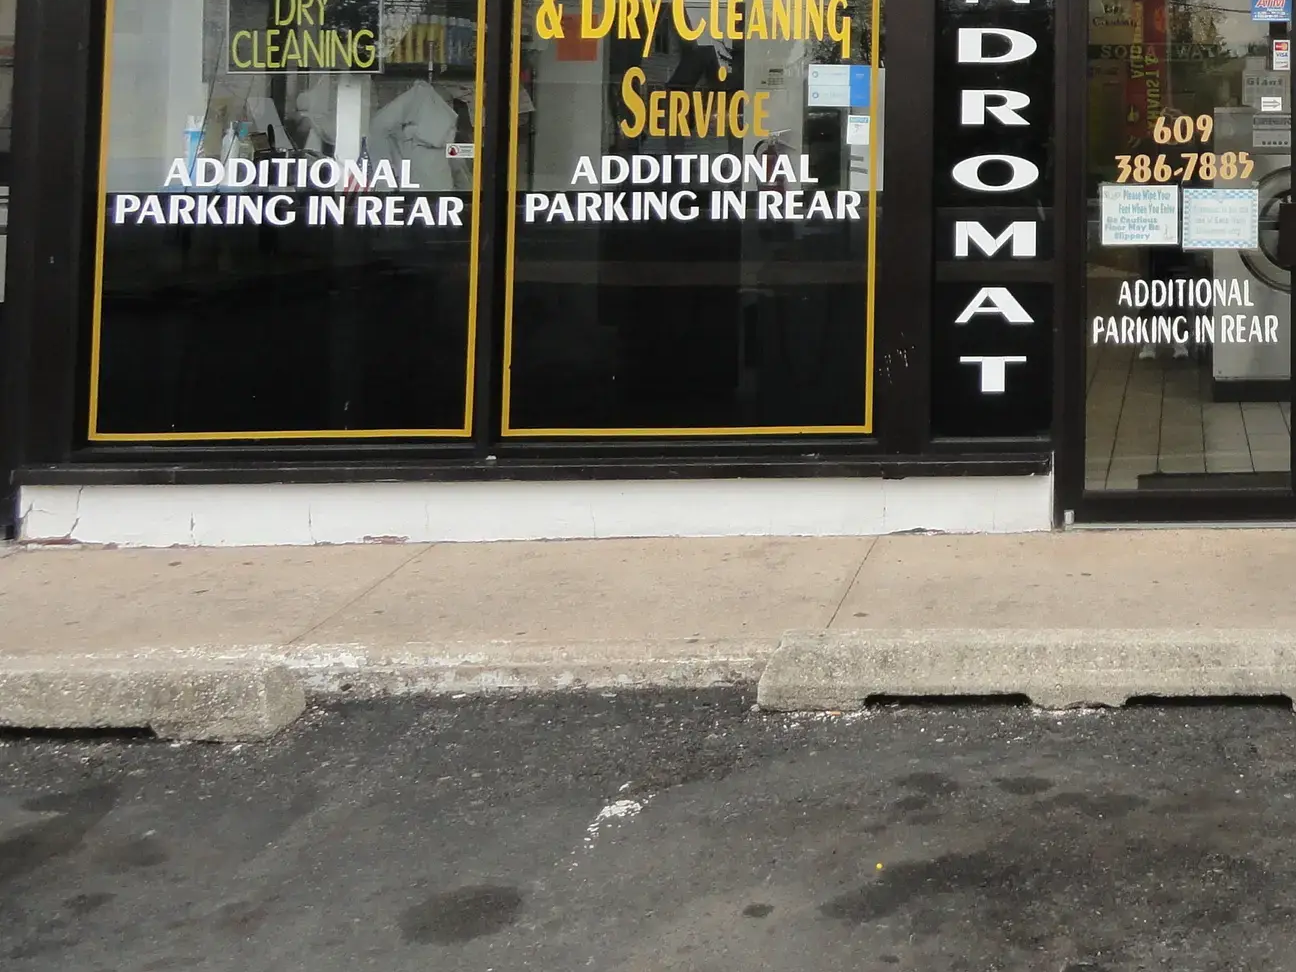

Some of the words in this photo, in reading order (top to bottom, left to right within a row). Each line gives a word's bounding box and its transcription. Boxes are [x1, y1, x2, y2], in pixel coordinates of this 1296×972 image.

[232, 29, 376, 69] CLEANING
[1153, 115, 1213, 145] 609
[164, 157, 420, 189] ADDITIONAL
[571, 154, 818, 185] ADDITIONAL
[1114, 152, 1255, 183] 386-7885
[114, 193, 296, 226] PARKING
[307, 195, 345, 226] IN
[356, 195, 464, 227] REAR
[525, 192, 700, 222] PARKING
[711, 191, 746, 221] IN
[758, 191, 861, 220] REAR
[1120, 216, 1158, 224] Cautious
[1114, 232, 1150, 241] Slippery
[1128, 224, 1147, 232] May
[1118, 278, 1255, 307] ADDITIONAL
[1092, 315, 1189, 344] PARKING
[1195, 316, 1215, 344] IN
[1220, 314, 1279, 343] REAR
